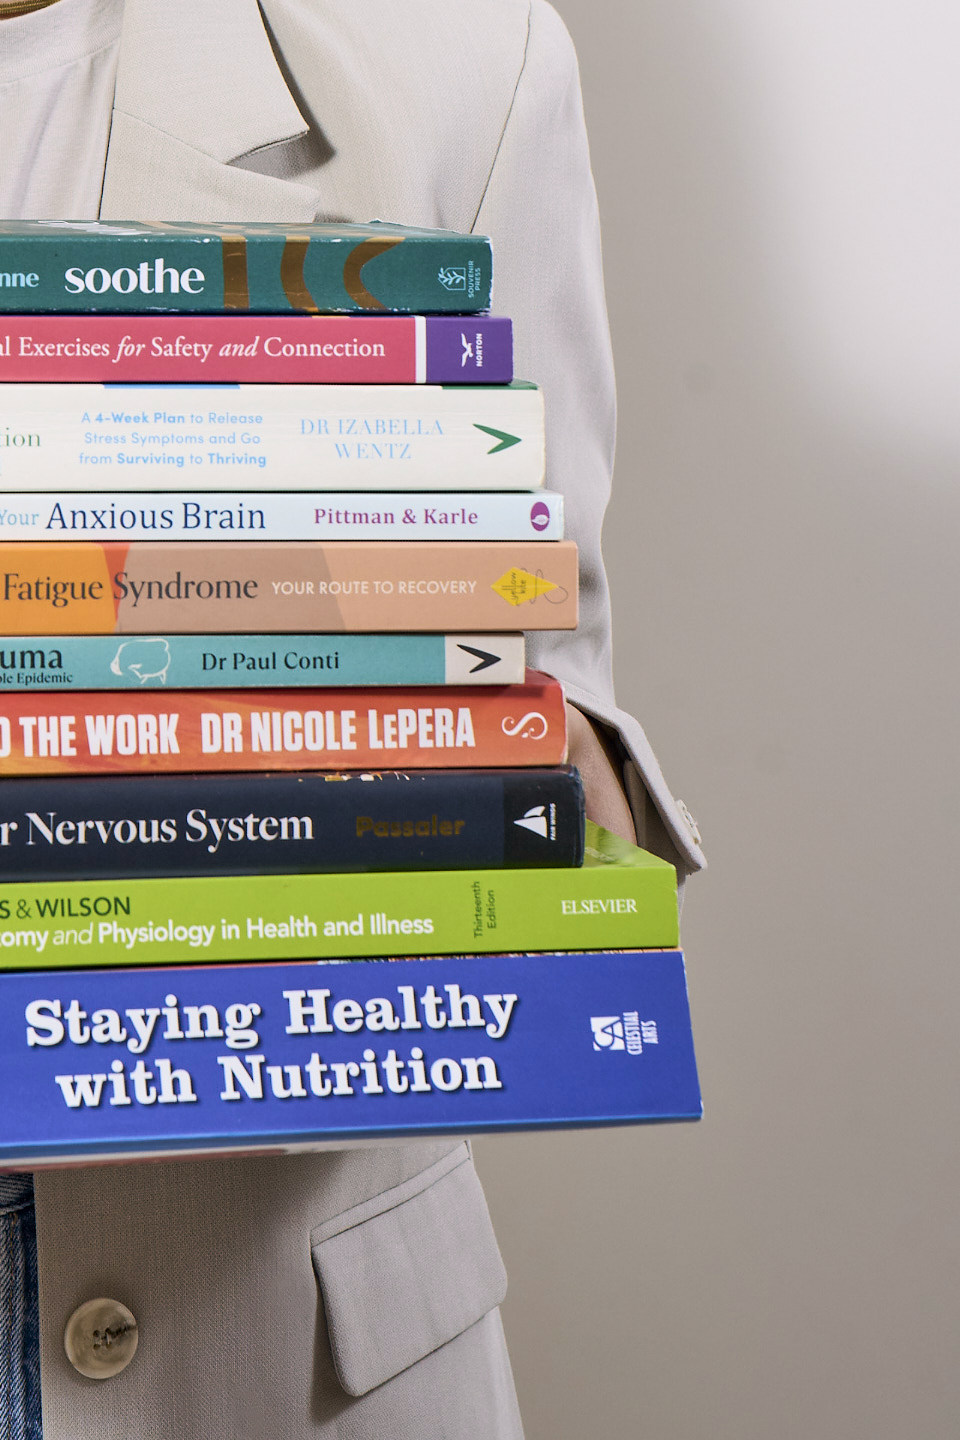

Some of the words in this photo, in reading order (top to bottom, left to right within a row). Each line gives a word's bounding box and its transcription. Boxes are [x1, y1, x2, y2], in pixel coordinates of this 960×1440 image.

[64, 258, 205, 295] soothe
[467, 260, 475, 298] SOUVENIR
[18, 336, 110, 358] Exercises
[112, 335, 146, 363] for
[150, 336, 214, 363] Safety
[218, 336, 260, 359] and
[263, 336, 386, 359] Connection
[475, 333, 483, 367] NORTON
[81, 412, 91, 424] A
[94, 411, 150, 424] 4-Week
[153, 411, 186, 424] Plan
[190, 412, 204, 424] to
[208, 411, 263, 424] Release
[300, 418, 330, 436] DR
[338, 417, 445, 436] IZABELLA
[84, 432, 127, 445] Stress
[131, 432, 205, 448] Symptoms
[208, 432, 237, 445] and
[240, 432, 261, 445] Go
[334, 442, 413, 460] WENTZ
[78, 452, 113, 465] from
[116, 452, 185, 468] Surviving
[189, 453, 203, 465] to
[207, 452, 267, 468] Thriving
[45, 502, 174, 531] Anxious
[181, 502, 267, 530] Brain
[313, 508, 396, 526] Pittman
[401, 508, 417, 525] &
[423, 507, 480, 526] Karle
[3, 572, 104, 609] Fatigue
[113, 571, 259, 608] Syndrome
[271, 581, 315, 596] YOUR
[318, 580, 369, 596] ROUTE
[373, 580, 394, 595] TO
[398, 580, 478, 595] RECOVERY
[202, 652, 227, 671] Dr
[233, 651, 277, 671] Paul
[283, 650, 340, 670] Conti
[16, 671, 74, 687] Epidemic
[18, 715, 77, 757] THE
[85, 713, 181, 756] WORK
[200, 713, 243, 754] DR
[250, 710, 357, 752] NICOLE
[24, 811, 178, 846] Nervous
[185, 808, 315, 854] System
[356, 814, 466, 838] Passaler
[15, 900, 33, 919] &
[35, 896, 131, 918] WILSON
[472, 880, 483, 939] Thirteenth
[486, 889, 497, 929] Edition
[560, 898, 638, 915] ELSEVIER
[52, 923, 93, 946] and
[97, 918, 216, 949] Physiology
[221, 918, 240, 940] in
[246, 915, 317, 940] Health
[323, 913, 365, 937] and
[370, 912, 435, 935] Illness
[23, 994, 263, 1055] Staying
[283, 983, 519, 1040] Healthy
[641, 1020, 659, 1045] ARTS
[55, 1057, 198, 1109] with
[216, 1046, 503, 1101] Nutrition
